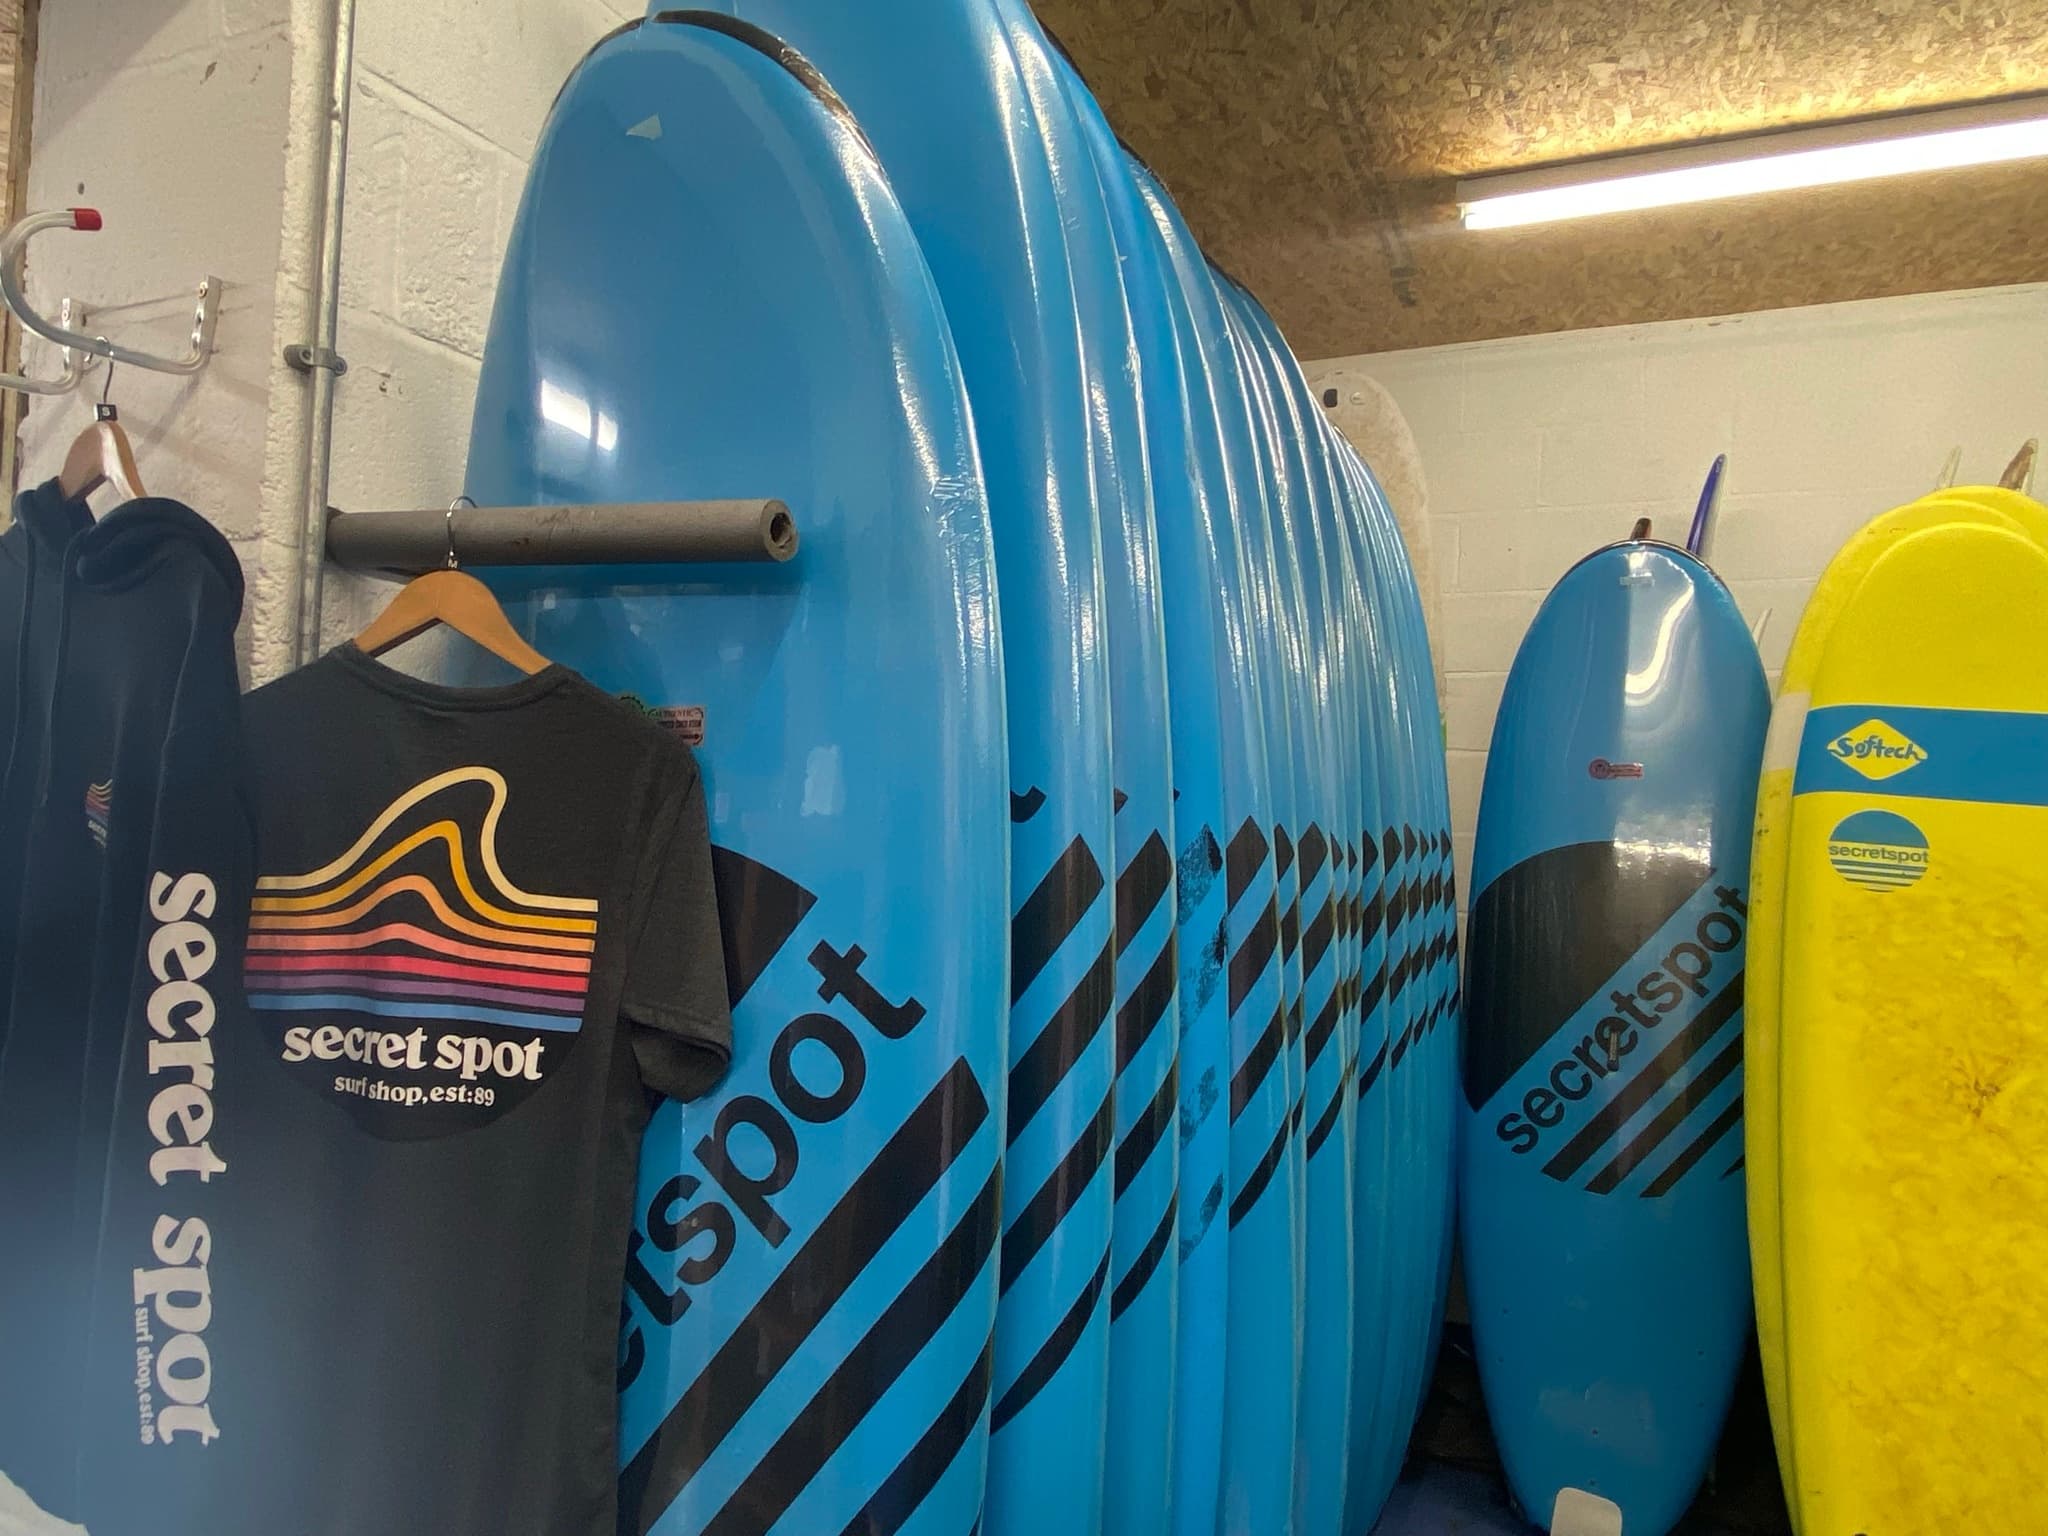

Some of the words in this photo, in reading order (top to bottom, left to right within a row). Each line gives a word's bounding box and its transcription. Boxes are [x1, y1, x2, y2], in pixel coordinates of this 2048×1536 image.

[1828, 735, 1927, 761] Softech
[1829, 845, 1930, 863] secretspot
[147, 871, 227, 1186] secret
[281, 1025, 428, 1070] secret
[433, 1034, 545, 1081] spot
[334, 1075, 367, 1097] surf
[133, 1214, 220, 1446] spot
[135, 1307, 153, 1343] surf
